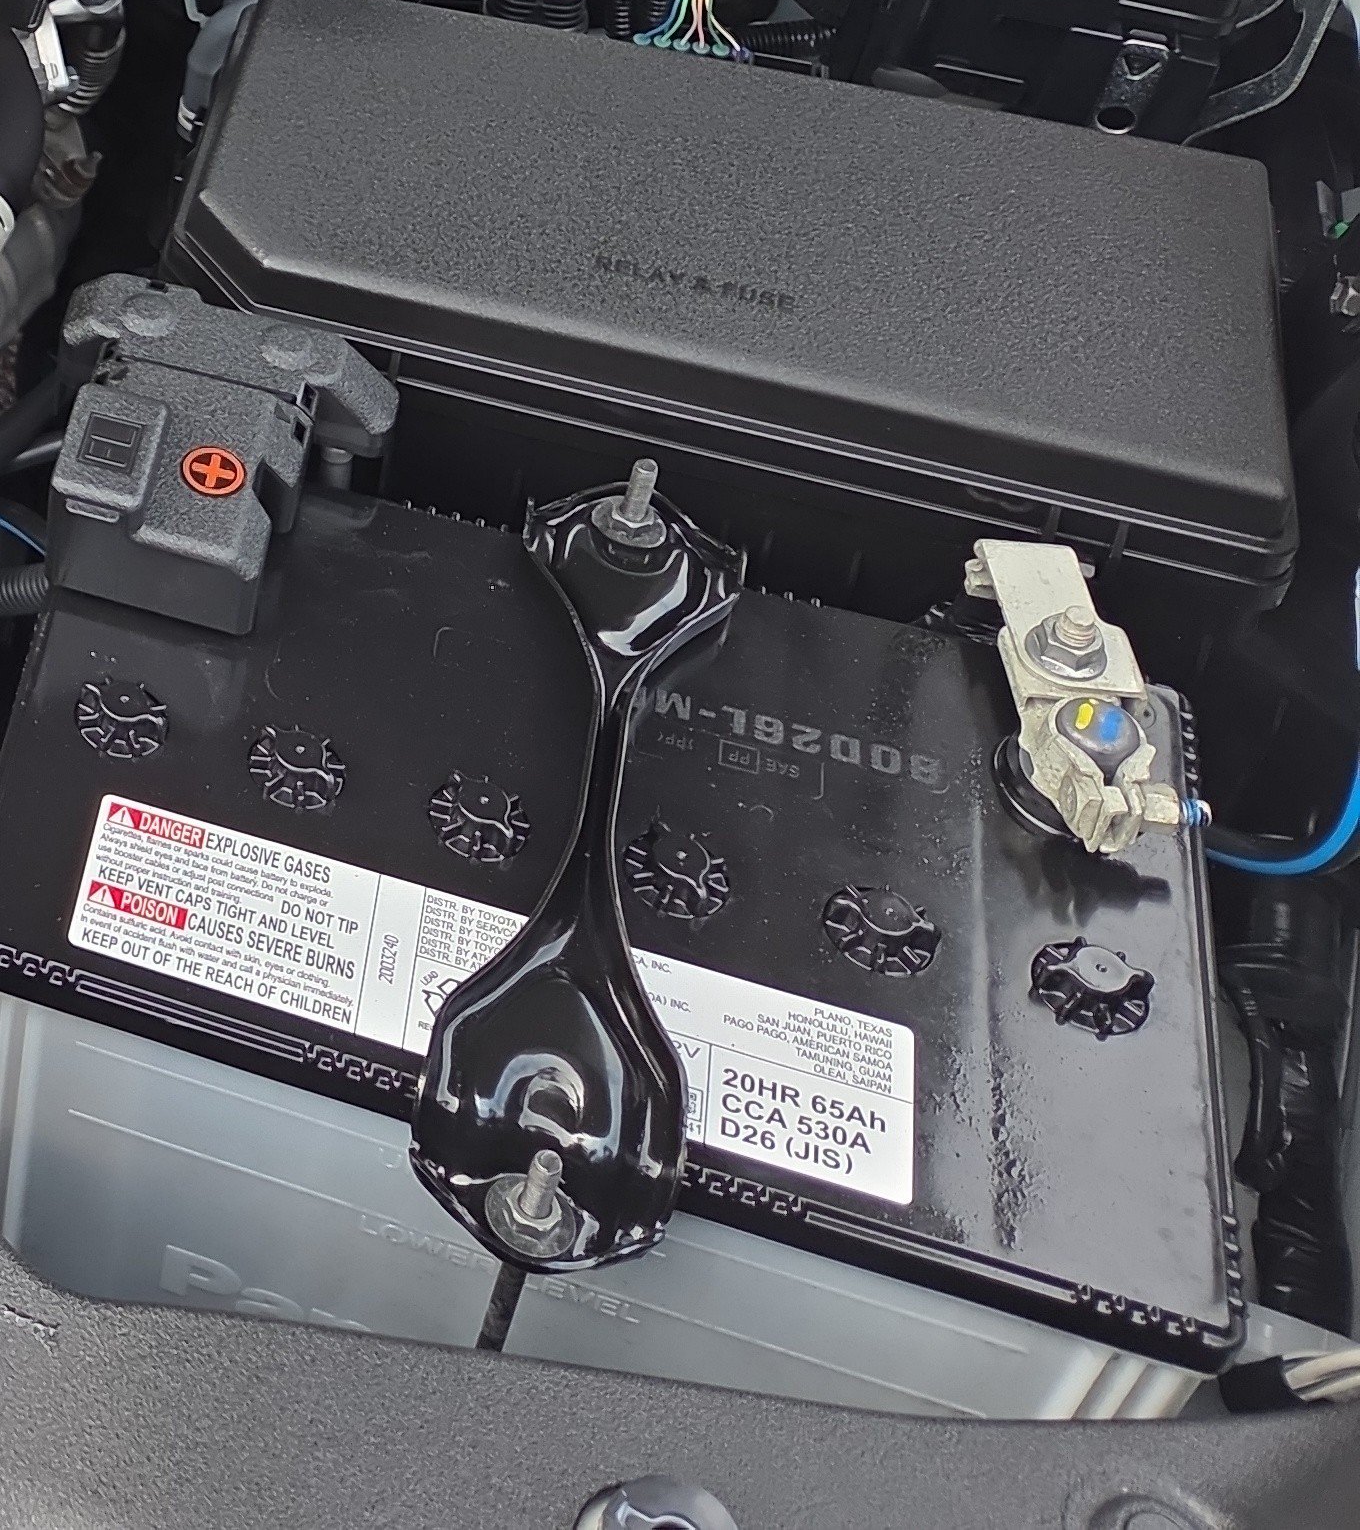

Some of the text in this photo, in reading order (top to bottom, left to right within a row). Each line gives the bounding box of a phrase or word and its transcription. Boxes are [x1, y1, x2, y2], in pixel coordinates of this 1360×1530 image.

[137, 812, 332, 884] DANGER EXPLOSIVE GASES
[173, 845, 182, 853] or
[183, 847, 209, 862] sparks
[211, 855, 233, 868] could
[234, 863, 258, 876] cause
[259, 869, 288, 885] battery
[94, 853, 123, 868] without
[123, 863, 150, 877] proper
[151, 870, 192, 888] instruction
[193, 882, 209, 893] and
[97, 844, 274, 902] use booster cables or adjust post connections
[99, 833, 128, 848] Always
[129, 841, 152, 854] shield
[153, 850, 173, 862] eyes
[174, 855, 190, 865] and
[190, 860, 208, 871] face
[210, 865, 228, 877] from
[261, 881, 273, 890] Do
[274, 885, 288, 895] not
[288, 889, 318, 905] charge
[318, 899, 328, 907] or
[97, 865, 337, 949] KEEP VENT CAPS TIGHT AND LEVEL
[279, 900, 359, 935] DO NOT TIP
[423, 915, 457, 932] DISTR.
[458, 925, 472, 937] BY
[426, 894, 519, 928] DISTR. BY TOYOTA
[459, 915, 474, 926] BY
[80, 913, 88, 922] In
[89, 917, 112, 930] event
[112, 924, 122, 932] of
[122, 927, 157, 943] accident
[157, 938, 177, 950] flush
[178, 944, 195, 956] with
[196, 950, 219, 963] water
[221, 958, 237, 968] and
[238, 963, 253, 974] call
[261, 970, 301, 990] physician
[82, 903, 118, 920] Contains
[169, 930, 192, 944] Avoid
[193, 937, 223, 953] contact
[224, 948, 242, 959] with
[263, 961, 284, 973] eyes
[285, 967, 294, 975] or
[118, 891, 357, 979] POISON CAUSES SEVERE BURNS
[419, 935, 454, 952] DISTR.
[455, 946, 470, 957] BY
[421, 925, 455, 942] DISTR.
[456, 936, 471, 947] BY
[81, 927, 353, 1024] KEEP OUT OF THE REACH OF CHILDREN
[420, 970, 439, 987] LEAD
[453, 956, 468, 967] BY
[723, 1014, 893, 1071] PAGO PAGO, AMERICAN SAMOA
[757, 1014, 891, 1060] SAN JUAN, PUERTO RICO
[788, 1011, 891, 1049] HONOLULU, HAWAII
[814, 1007, 892, 1038] PLANO, TEXAS
[795, 1047, 891, 1082] TAMUNING, GUAM
[813, 1063, 891, 1094] OLEAI, SAIPAN
[722, 1067, 886, 1132] 20HR 65Ah
[722, 1091, 788, 1129] CCA
[798, 1115, 872, 1154] 530A
[720, 1116, 776, 1150] D26
[786, 1136, 852, 1175] (JIS)
[355, 1214, 500, 1274] LOWER
